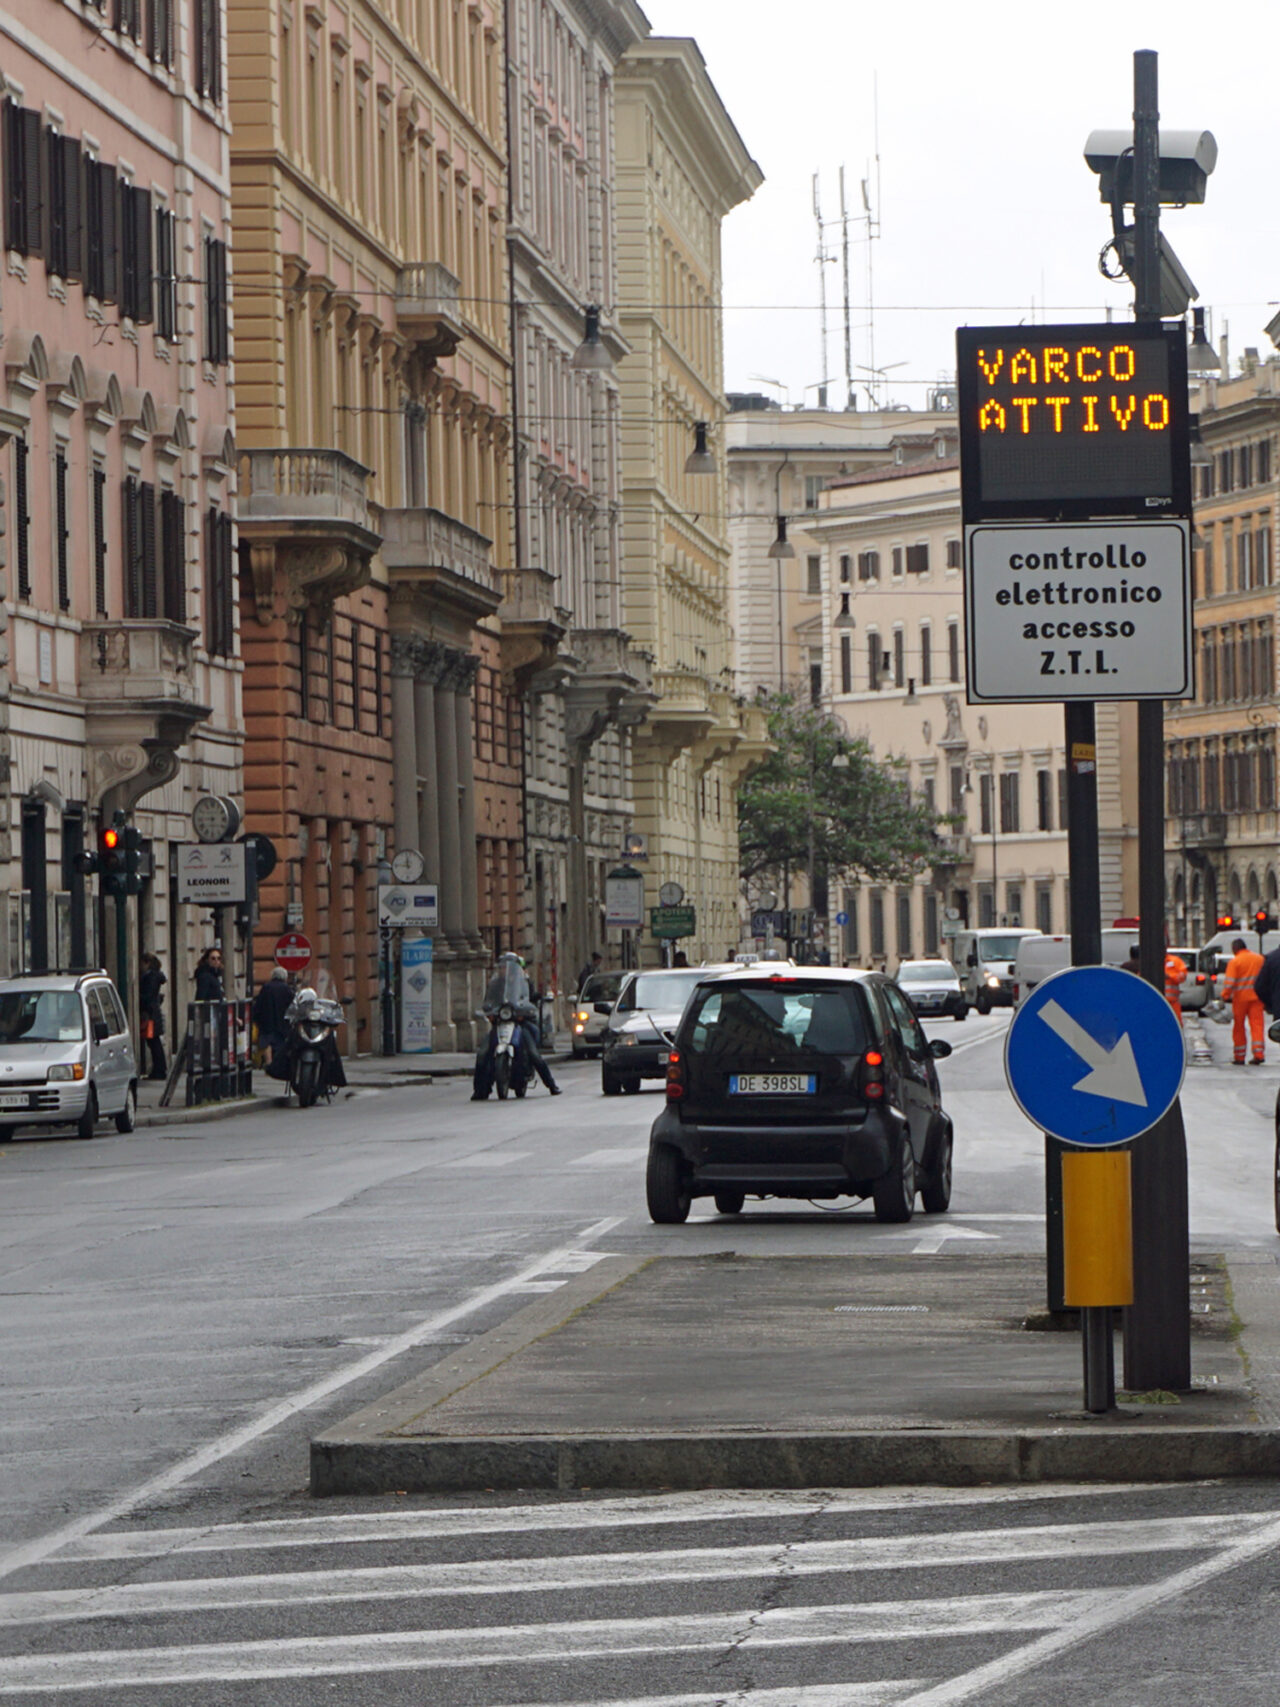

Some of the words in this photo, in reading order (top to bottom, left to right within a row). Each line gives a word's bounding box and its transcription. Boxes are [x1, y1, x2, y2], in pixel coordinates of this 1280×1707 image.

[977, 345, 1136, 386] VARCO
[979, 393, 1170, 434] ATTIVO
[1008, 544, 1147, 571] controllo
[995, 578, 1163, 606] elettronico
[1022, 620, 1136, 640] accesso
[1040, 650, 1119, 676] Z.T.L.
[187, 878, 229, 887] LEONORI
[739, 1076, 756, 1091] DE
[761, 1076, 806, 1091] 398SL
